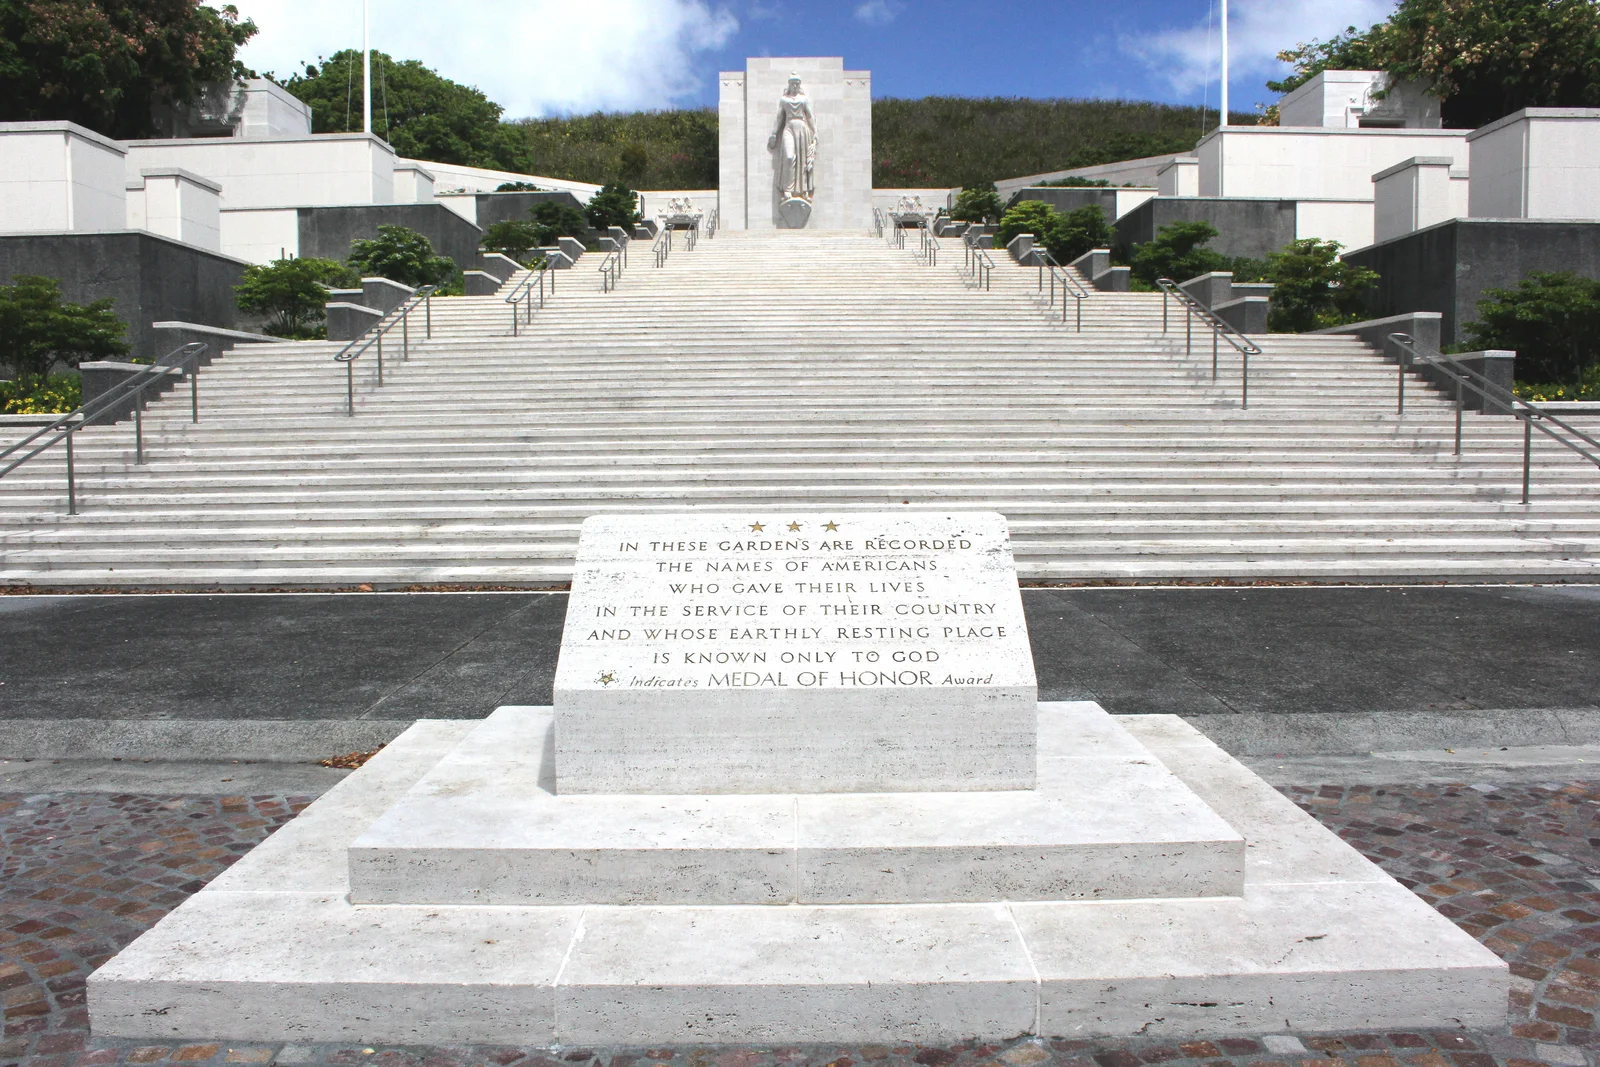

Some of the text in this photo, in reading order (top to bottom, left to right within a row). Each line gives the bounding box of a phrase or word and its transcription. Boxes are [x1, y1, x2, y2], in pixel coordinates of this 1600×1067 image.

[619, 540, 972, 552] IN THESE GARDENS ARE RECORDED
[656, 560, 937, 572] THE NAMES OF AMERICANS
[669, 582, 925, 593] WHO GAVE THEIR LIVES
[596, 604, 996, 617] IN THE SERVICE OF THEIR COUNTRY
[587, 627, 1007, 640] AND WHOSE EARTHLY RESTING PLACE
[653, 651, 939, 664] IS KNOWN ONLY TO GOD
[629, 671, 994, 687] Indicates MEDAL OF HONOR Award
